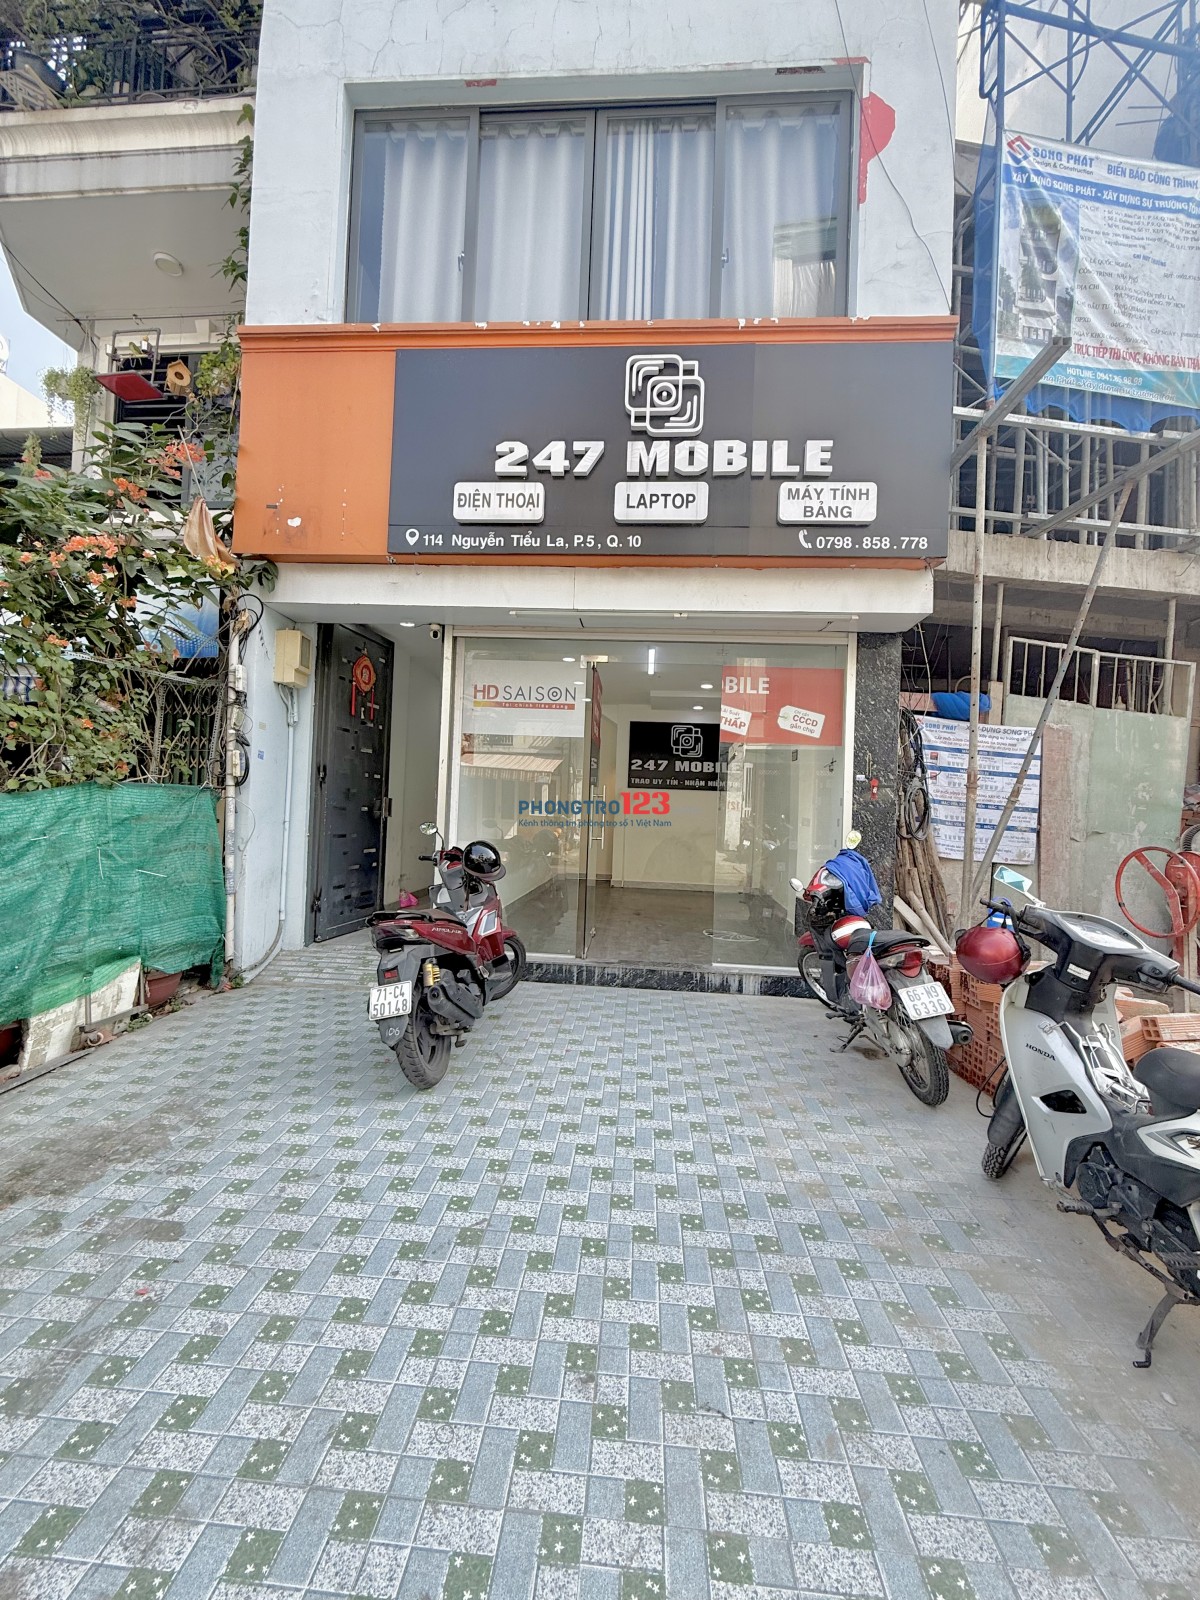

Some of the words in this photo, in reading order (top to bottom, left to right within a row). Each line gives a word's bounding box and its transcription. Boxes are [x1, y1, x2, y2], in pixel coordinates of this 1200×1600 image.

[1032, 147, 1063, 161] SONG
[1067, 153, 1095, 169] PHÁT
[1107, 162, 1126, 178] BIỂN
[1129, 166, 1145, 181] BÁO
[1148, 171, 1171, 186] CÔNG
[1172, 176, 1198, 189] TRÌNH
[1012, 171, 1029, 184] XÂY
[1030, 174, 1052, 187] DỰNG
[1053, 180, 1074, 193] SONG
[1075, 184, 1096, 197] PHÁT
[1103, 189, 1117, 201] XÂY
[1119, 193, 1140, 206] DỰNG
[1142, 197, 1154, 208] SỰ
[1154, 199, 1188, 210] TRƯỜNG
[494, 440, 605, 477] 247
[626, 440, 834, 477] MOBILE
[457, 489, 491, 512] ĐIỆN
[496, 492, 540, 512] THOẠI
[626, 493, 696, 509] LAPTOP
[787, 486, 822, 501] MÁY
[829, 485, 870, 501] TÍNH
[803, 501, 852, 518] BẢNG
[423, 534, 443, 546] 114
[451, 531, 505, 549] Nguyễn
[511, 530, 541, 547] Tiểu
[547, 534, 569, 549] La,
[722, 676, 770, 695] BILE
[792, 714, 818, 727] CCCD
[1002, 728, 1022, 736] SONG
[630, 759, 669, 771] 247
[674, 761, 741, 773] MOBILE
[630, 777, 650, 785] TRAO
[666, 776, 679, 786] TÍN
[684, 779, 706, 788] NHẬN
[376, 984, 405, 1002] 71-C4
[906, 985, 940, 1002] 66-N9
[373, 998, 408, 1017] 501.48
[912, 998, 947, 1017] 6336
[1025, 1043, 1056, 1061] HONDA
